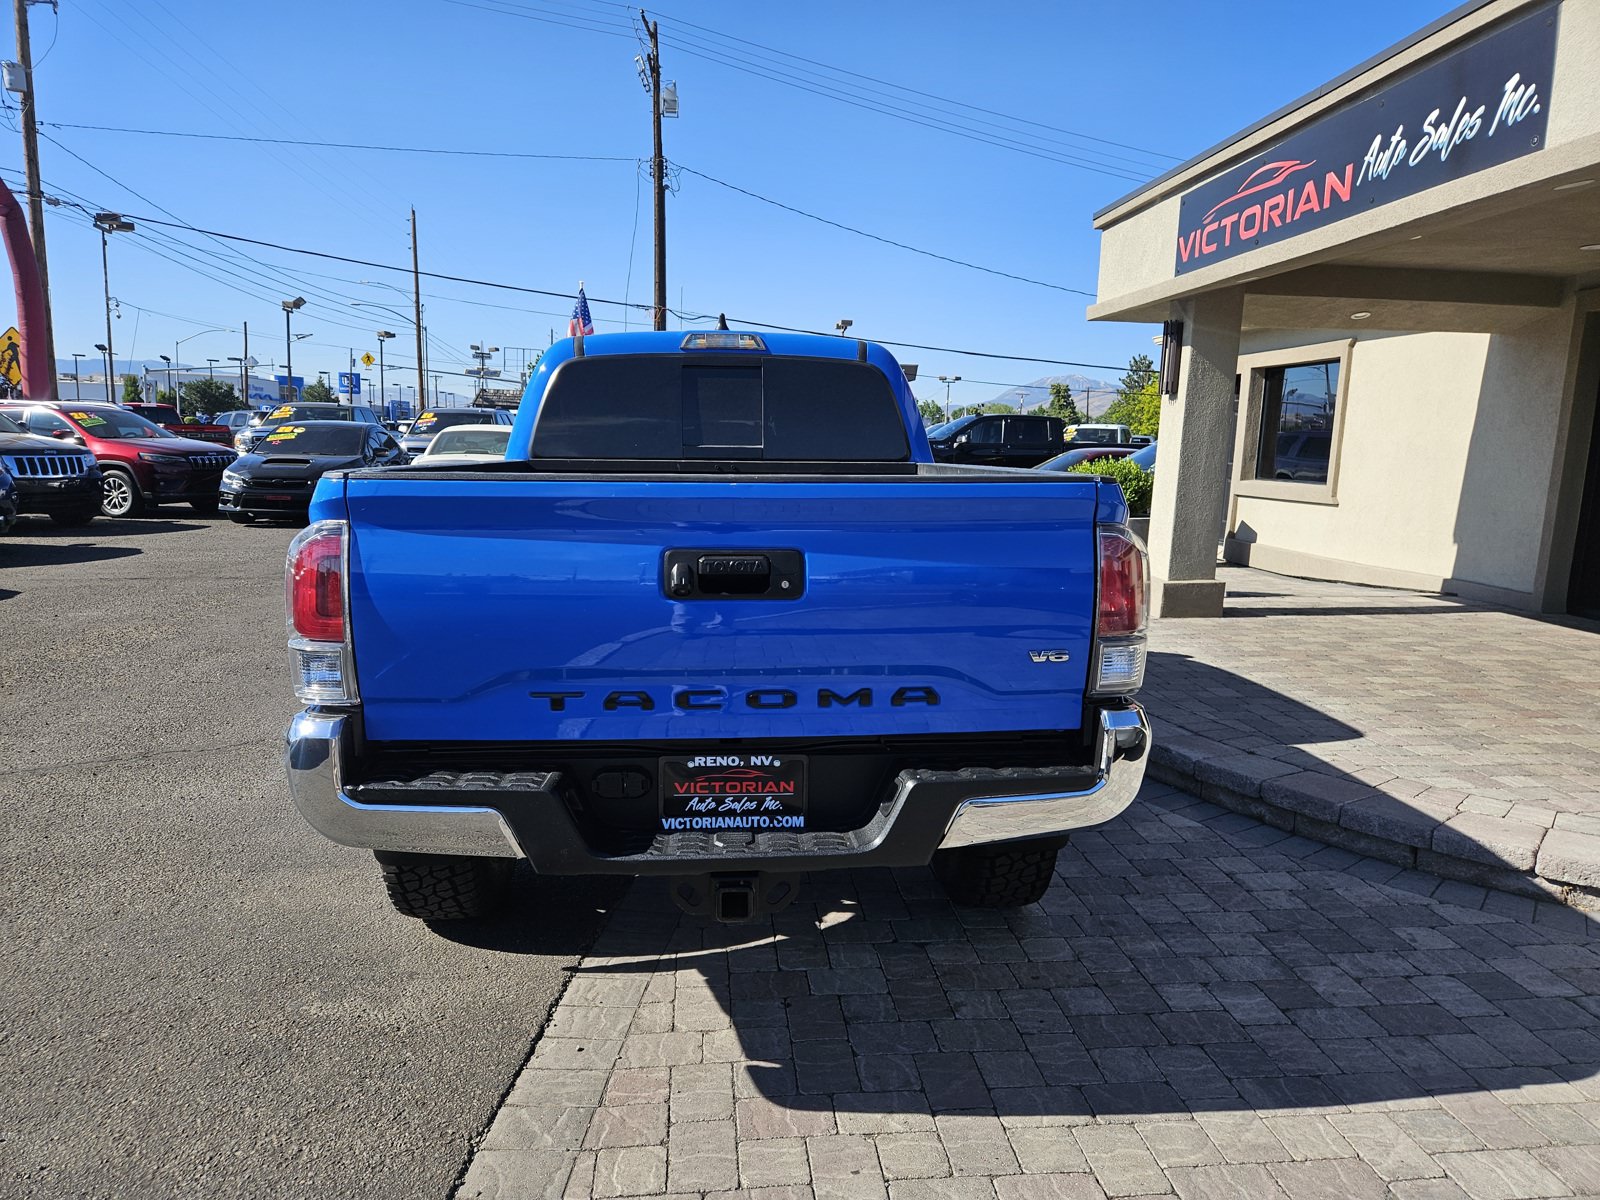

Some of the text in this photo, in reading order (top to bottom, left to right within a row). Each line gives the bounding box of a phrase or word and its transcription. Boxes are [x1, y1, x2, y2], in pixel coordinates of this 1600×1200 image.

[1356, 72, 1541, 187] Auto Sales Inc.
[1178, 162, 1354, 263] VICTORIAN
[704, 560, 762, 573] TOYOTA
[1029, 649, 1070, 662] V6
[529, 686, 942, 712] TACOMA
[694, 755, 773, 767] RENO, NV
[674, 780, 794, 794] VICTORIAN
[685, 796, 783, 813] Auto Sales Inc.
[661, 816, 805, 829] VICTORIANAUTO.COM
